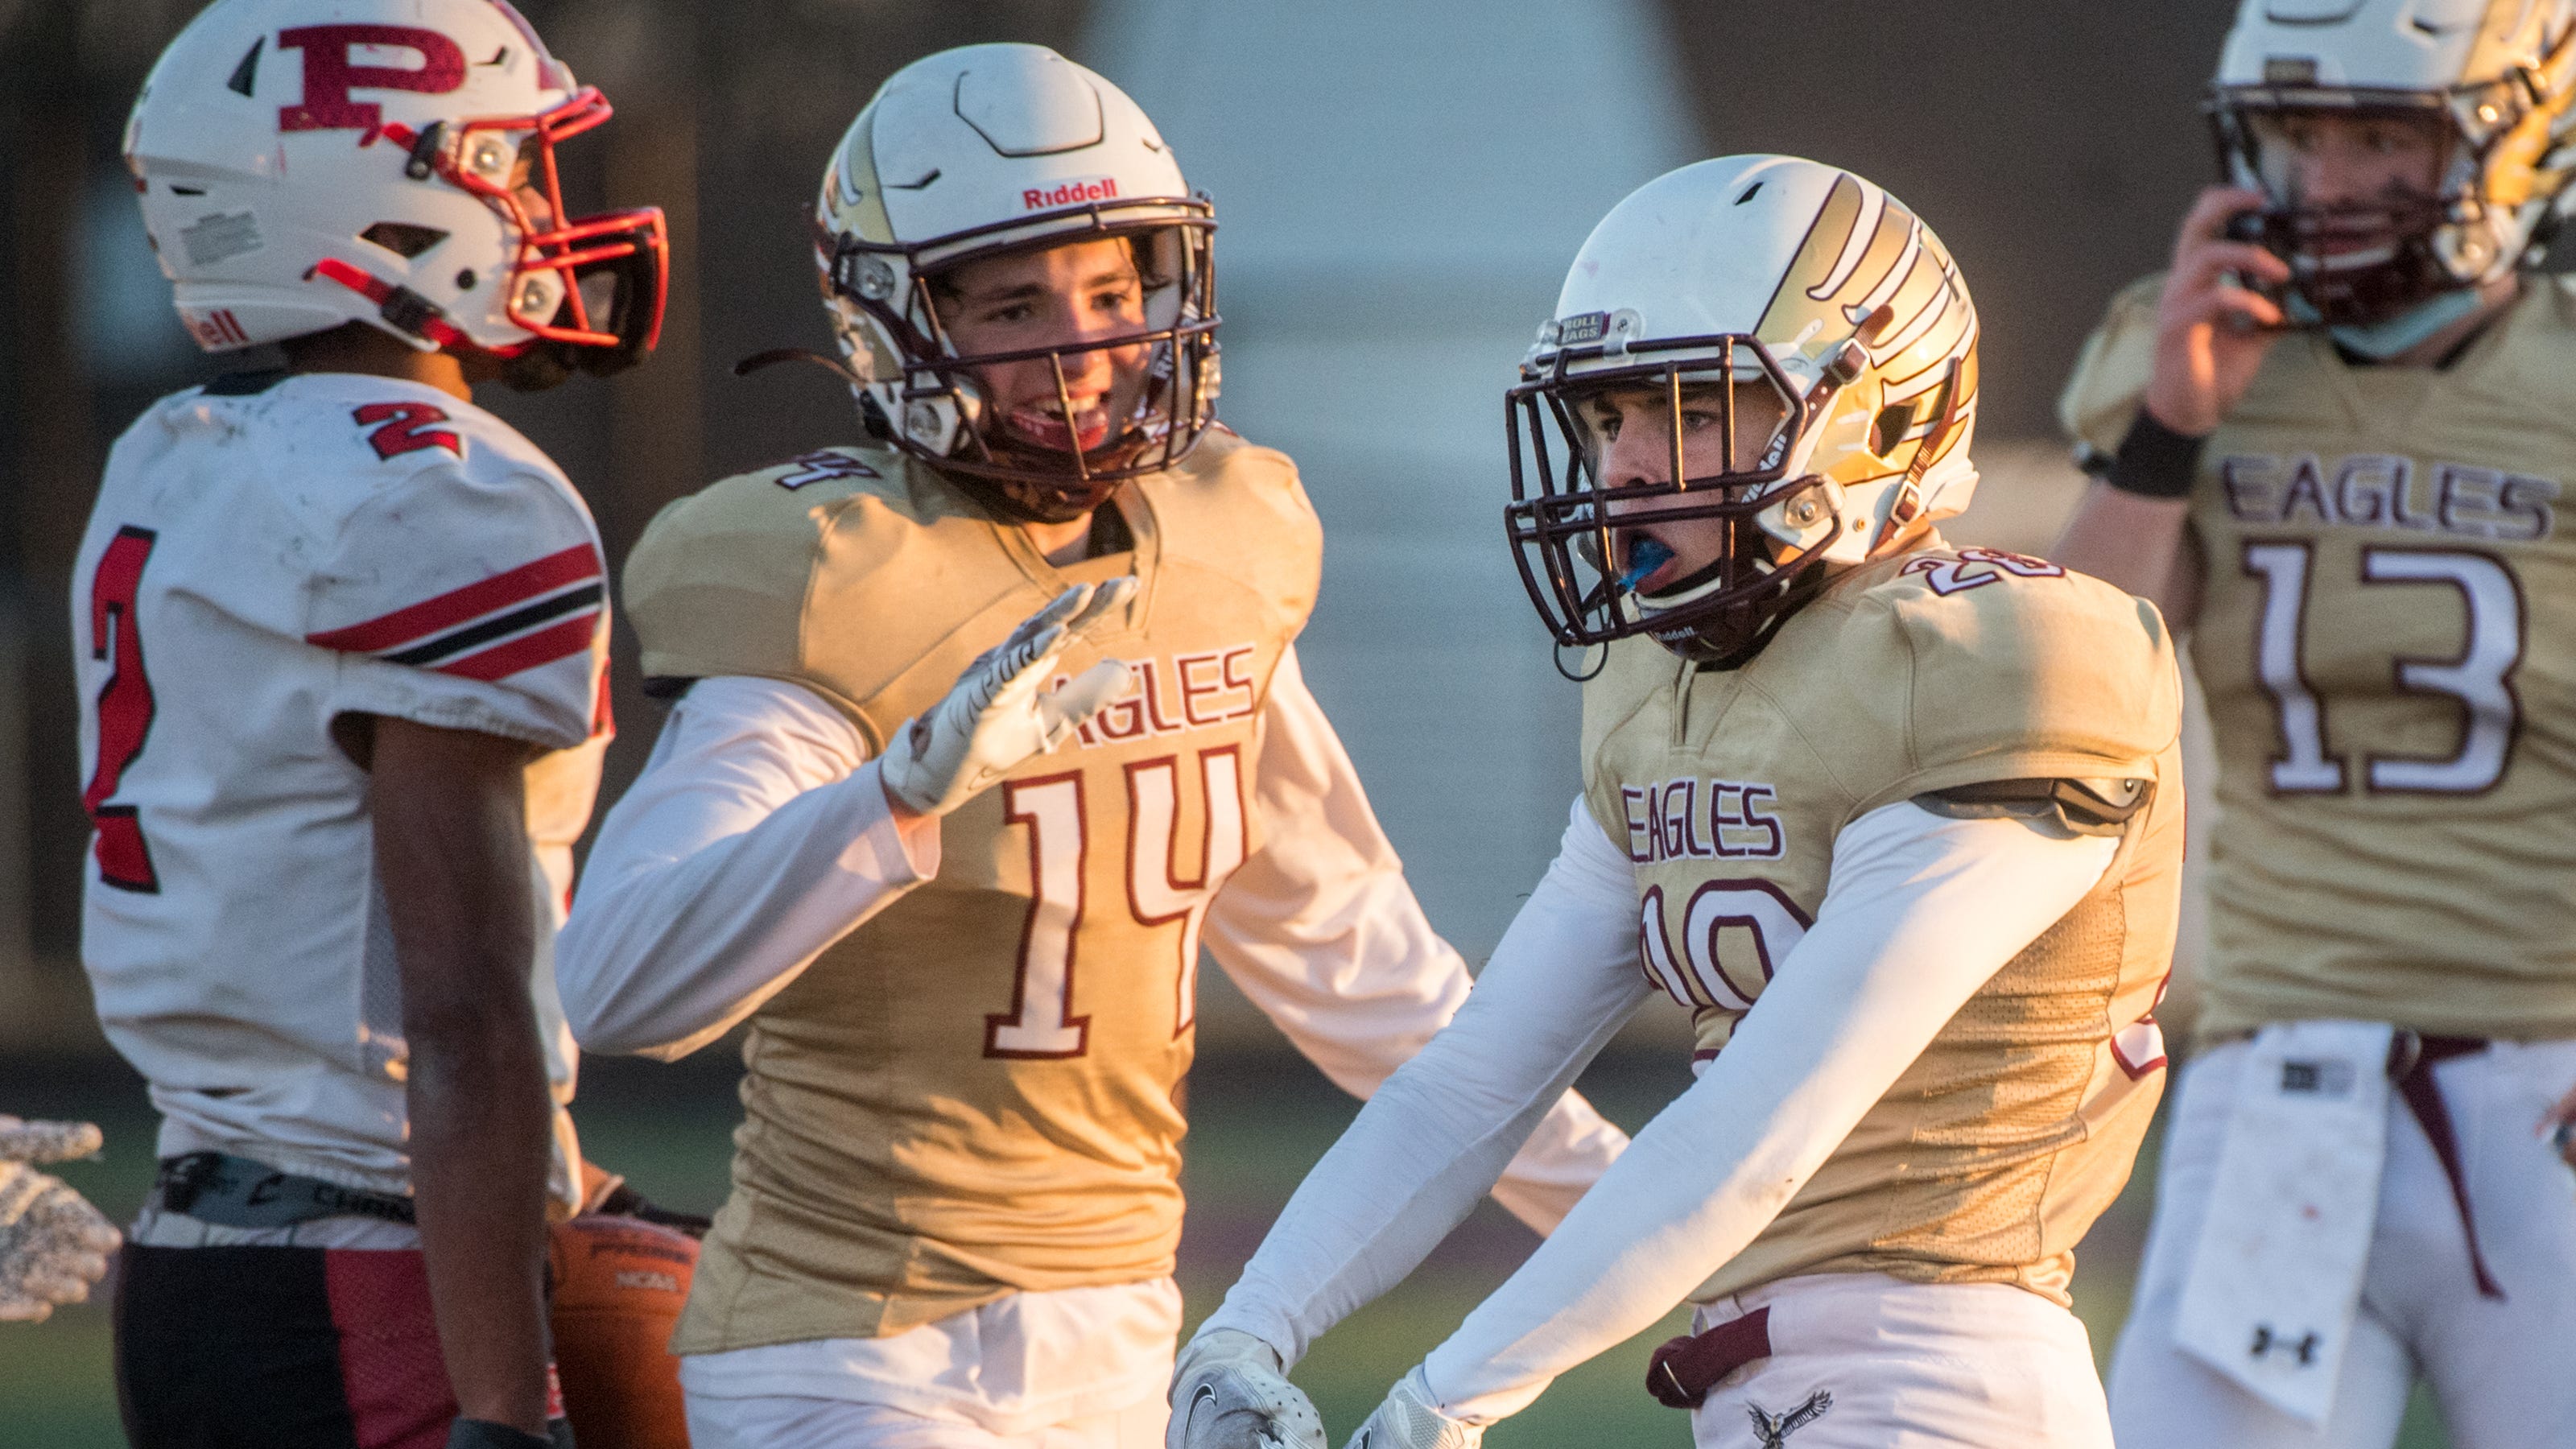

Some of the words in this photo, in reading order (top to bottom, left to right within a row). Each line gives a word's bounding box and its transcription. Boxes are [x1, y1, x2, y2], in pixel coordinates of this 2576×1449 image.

[278, 23, 467, 133] P
[1022, 178, 1118, 210] Riddell
[354, 402, 461, 460] 2
[2222, 453, 2560, 541] EAGLES
[1899, 548, 2067, 597] 28
[1654, 625, 1696, 642] Riddell
[2241, 535, 2530, 797] 13
[1055, 646, 1257, 749] GLES
[1621, 777, 1787, 867] EAGLES
[984, 742, 1250, 1061] 14
